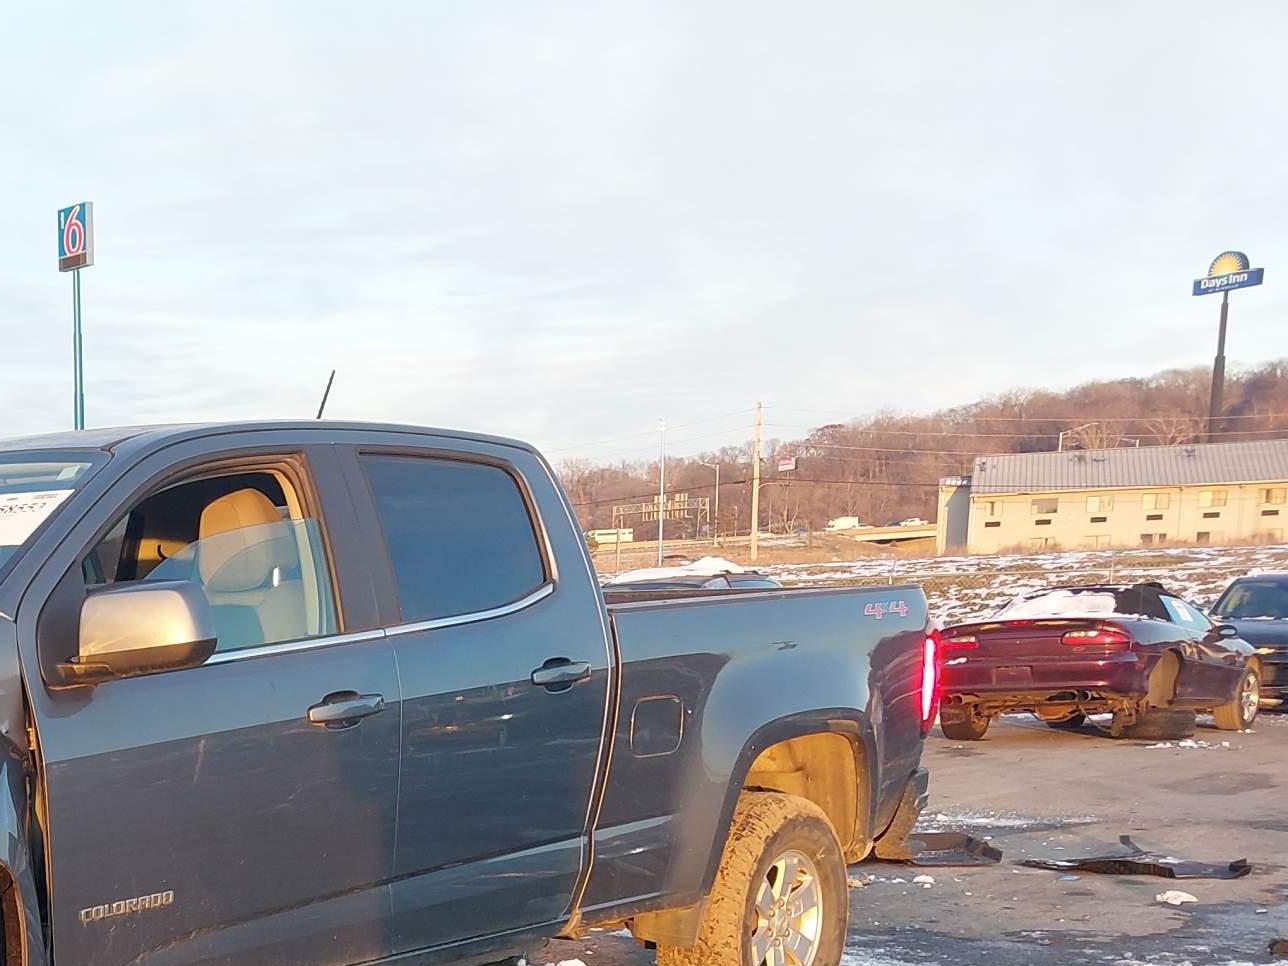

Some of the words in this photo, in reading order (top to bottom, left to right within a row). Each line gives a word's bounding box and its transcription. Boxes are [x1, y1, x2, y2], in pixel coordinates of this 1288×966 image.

[63, 205, 84, 257] 6
[1200, 277, 1228, 290] Days
[1228, 273, 1248, 284] Inn
[80, 890, 174, 922] COLORADO
